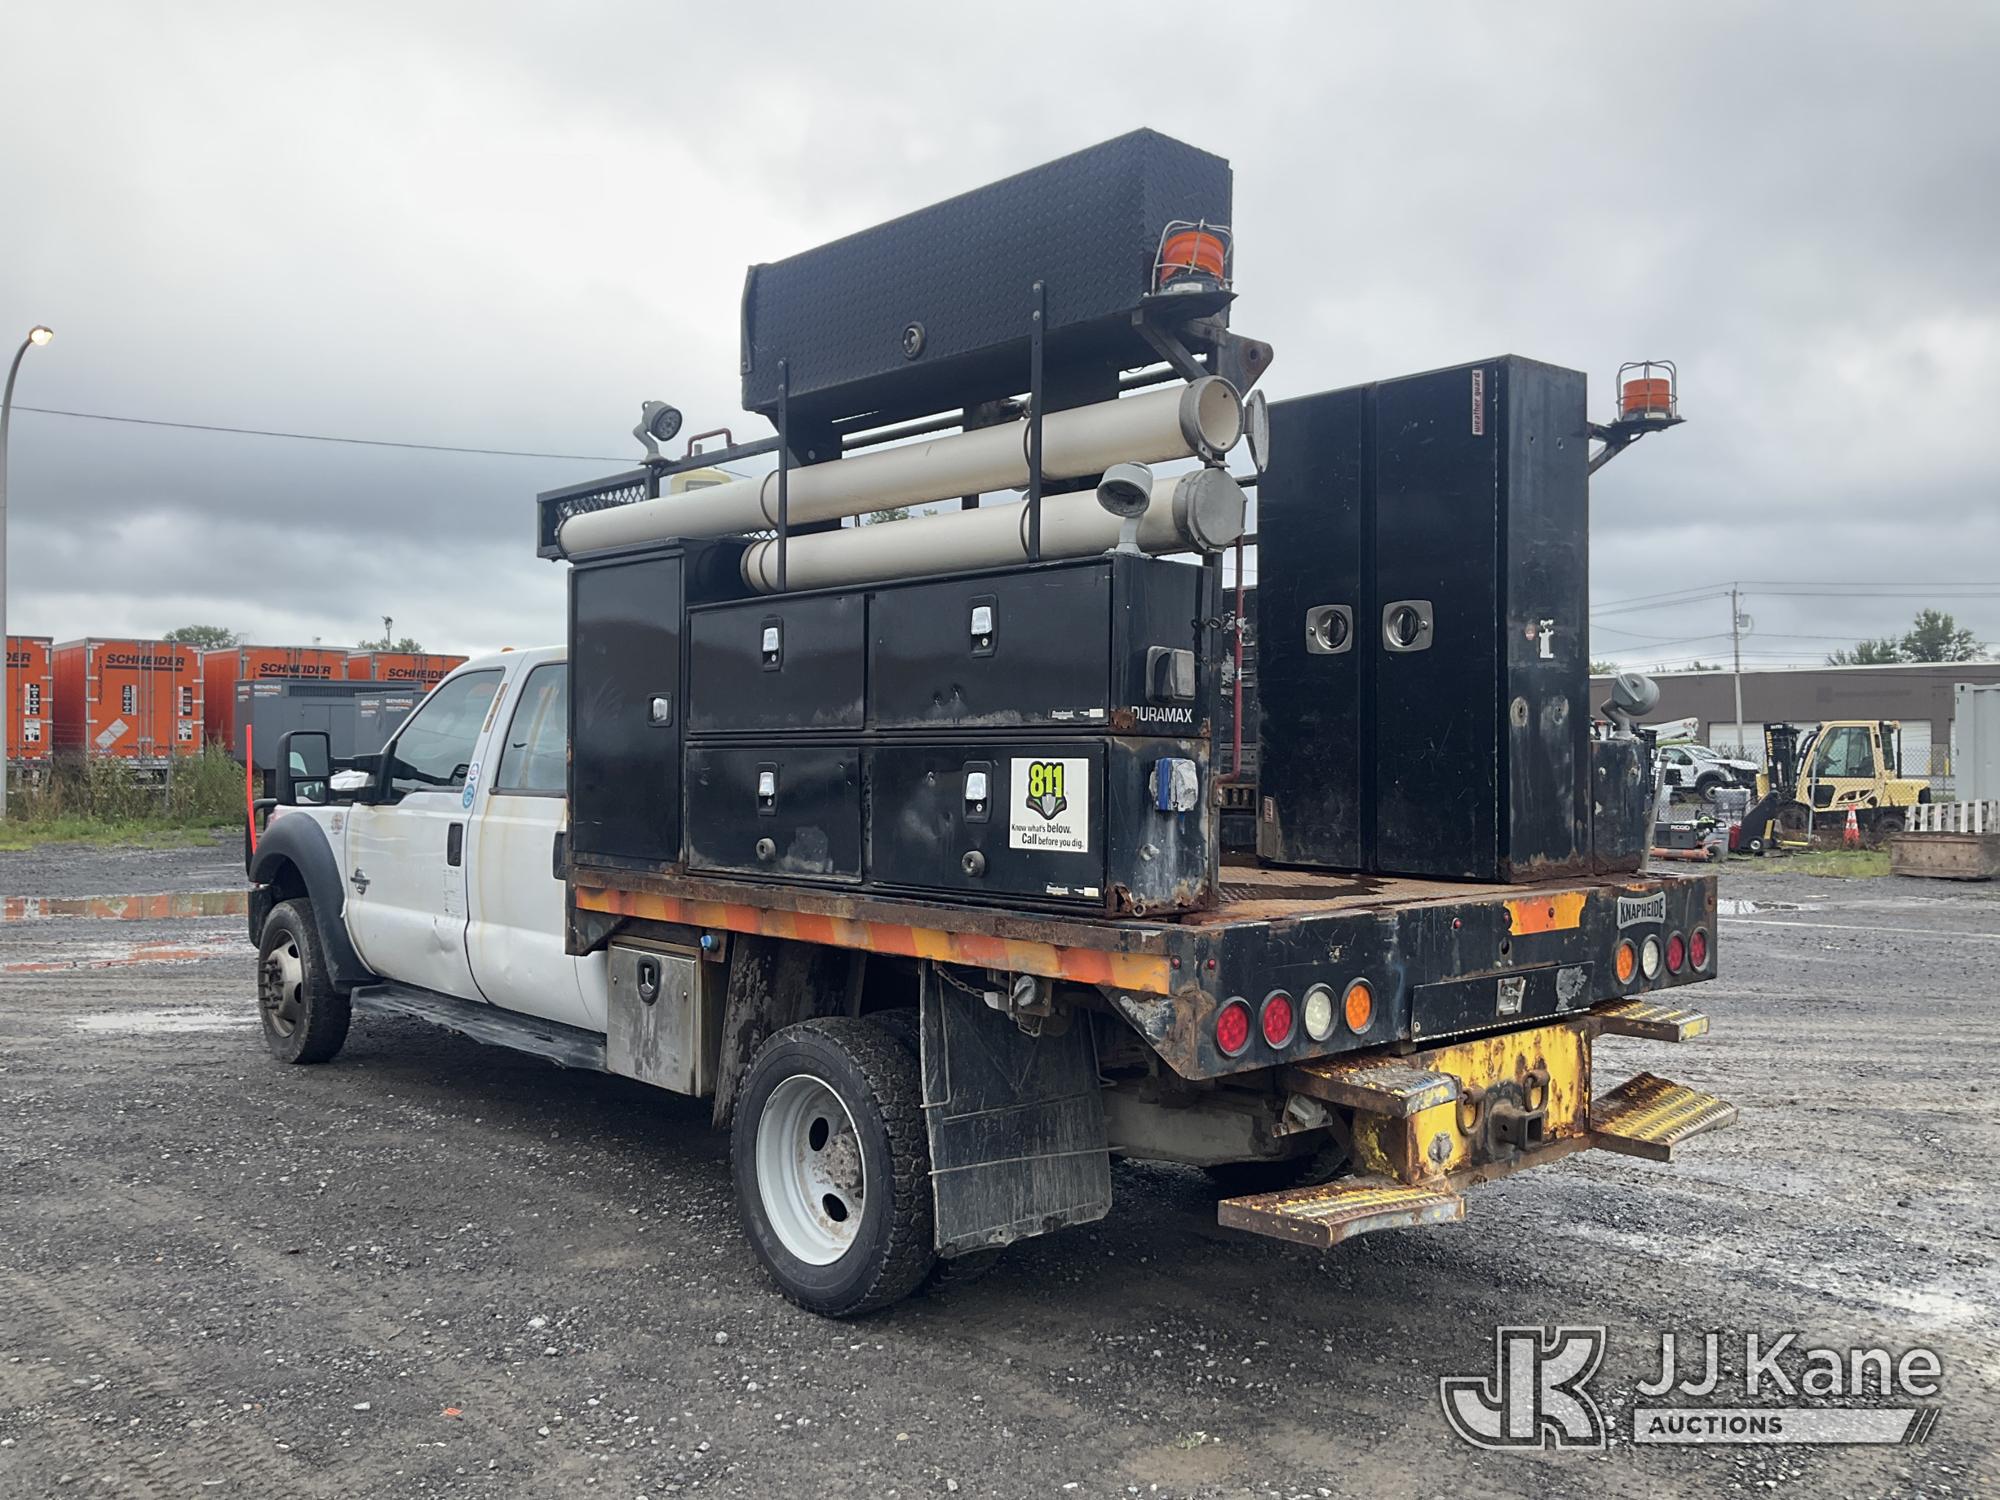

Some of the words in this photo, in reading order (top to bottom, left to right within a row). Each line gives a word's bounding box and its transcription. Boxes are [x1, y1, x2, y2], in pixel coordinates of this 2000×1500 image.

[106, 653, 185, 667] SCHNEIDER
[260, 662, 332, 675] SCHNEIDER
[1131, 706, 1193, 723] DURAMAX
[1029, 762, 1063, 799] 811
[1027, 824, 1046, 833] what's
[1046, 823, 1072, 834] below.
[1022, 832, 1037, 845] Call
[1038, 837, 1059, 846] before
[1059, 839, 1071, 848] you
[1620, 897, 1664, 924] KNAPHEIDE
